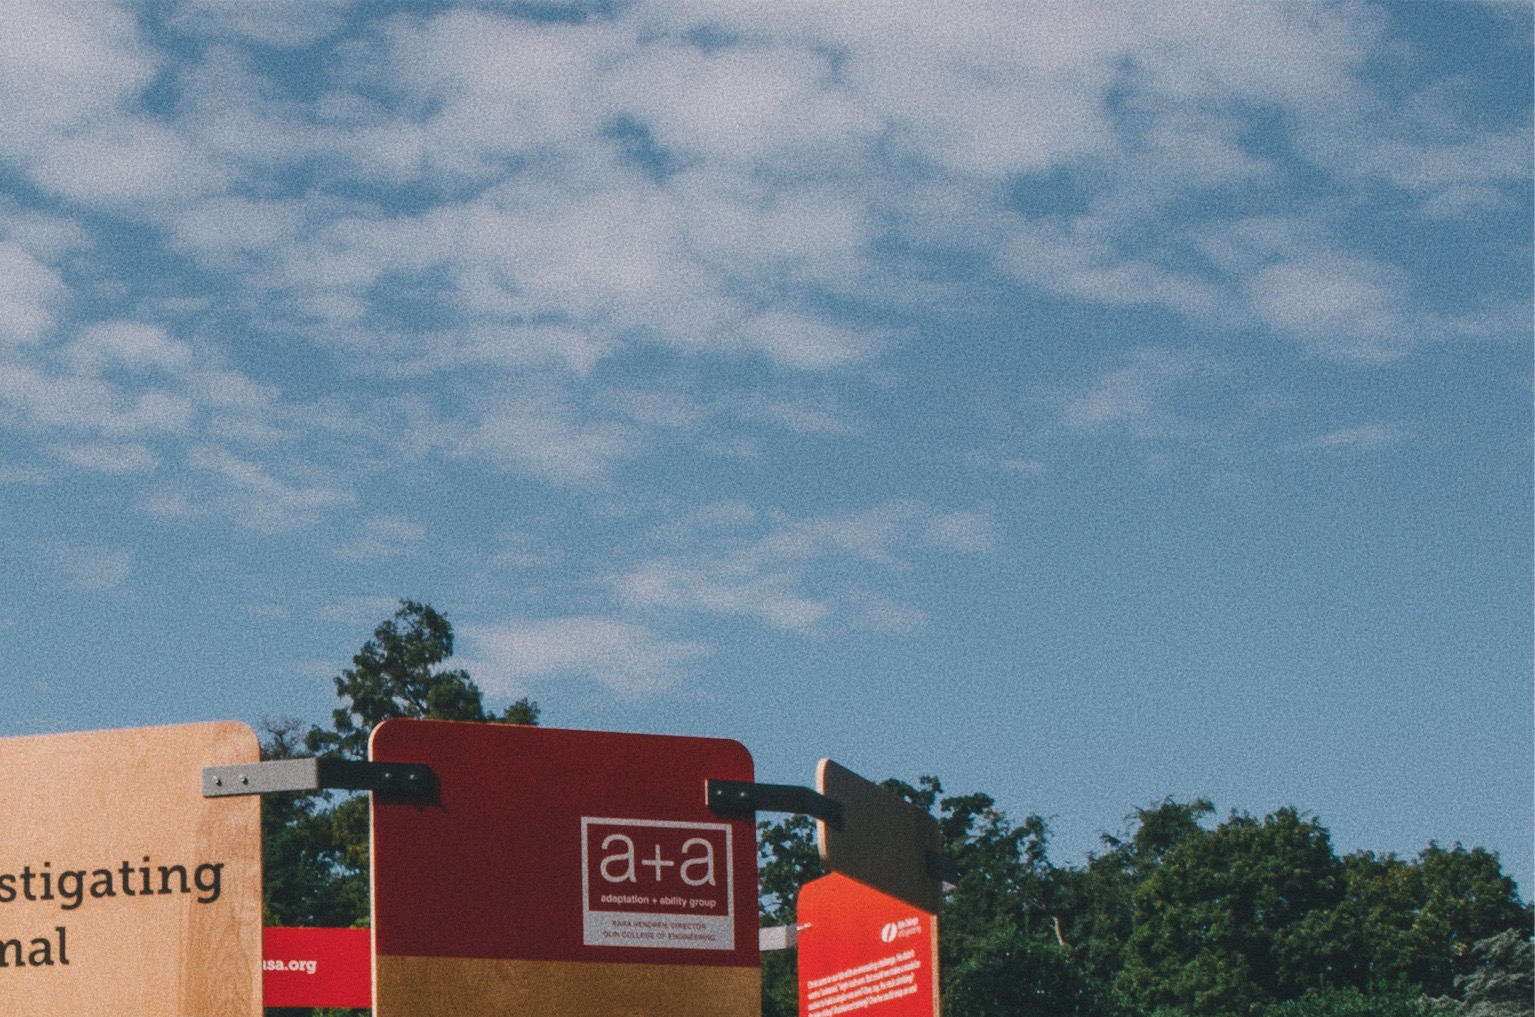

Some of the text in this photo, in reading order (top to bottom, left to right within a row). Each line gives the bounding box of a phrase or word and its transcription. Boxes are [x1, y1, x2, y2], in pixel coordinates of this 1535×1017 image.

[600, 833, 716, 886] a+a
[600, 894, 650, 905] adaptation
[659, 895, 687, 907] ability
[689, 898, 716, 909] group
